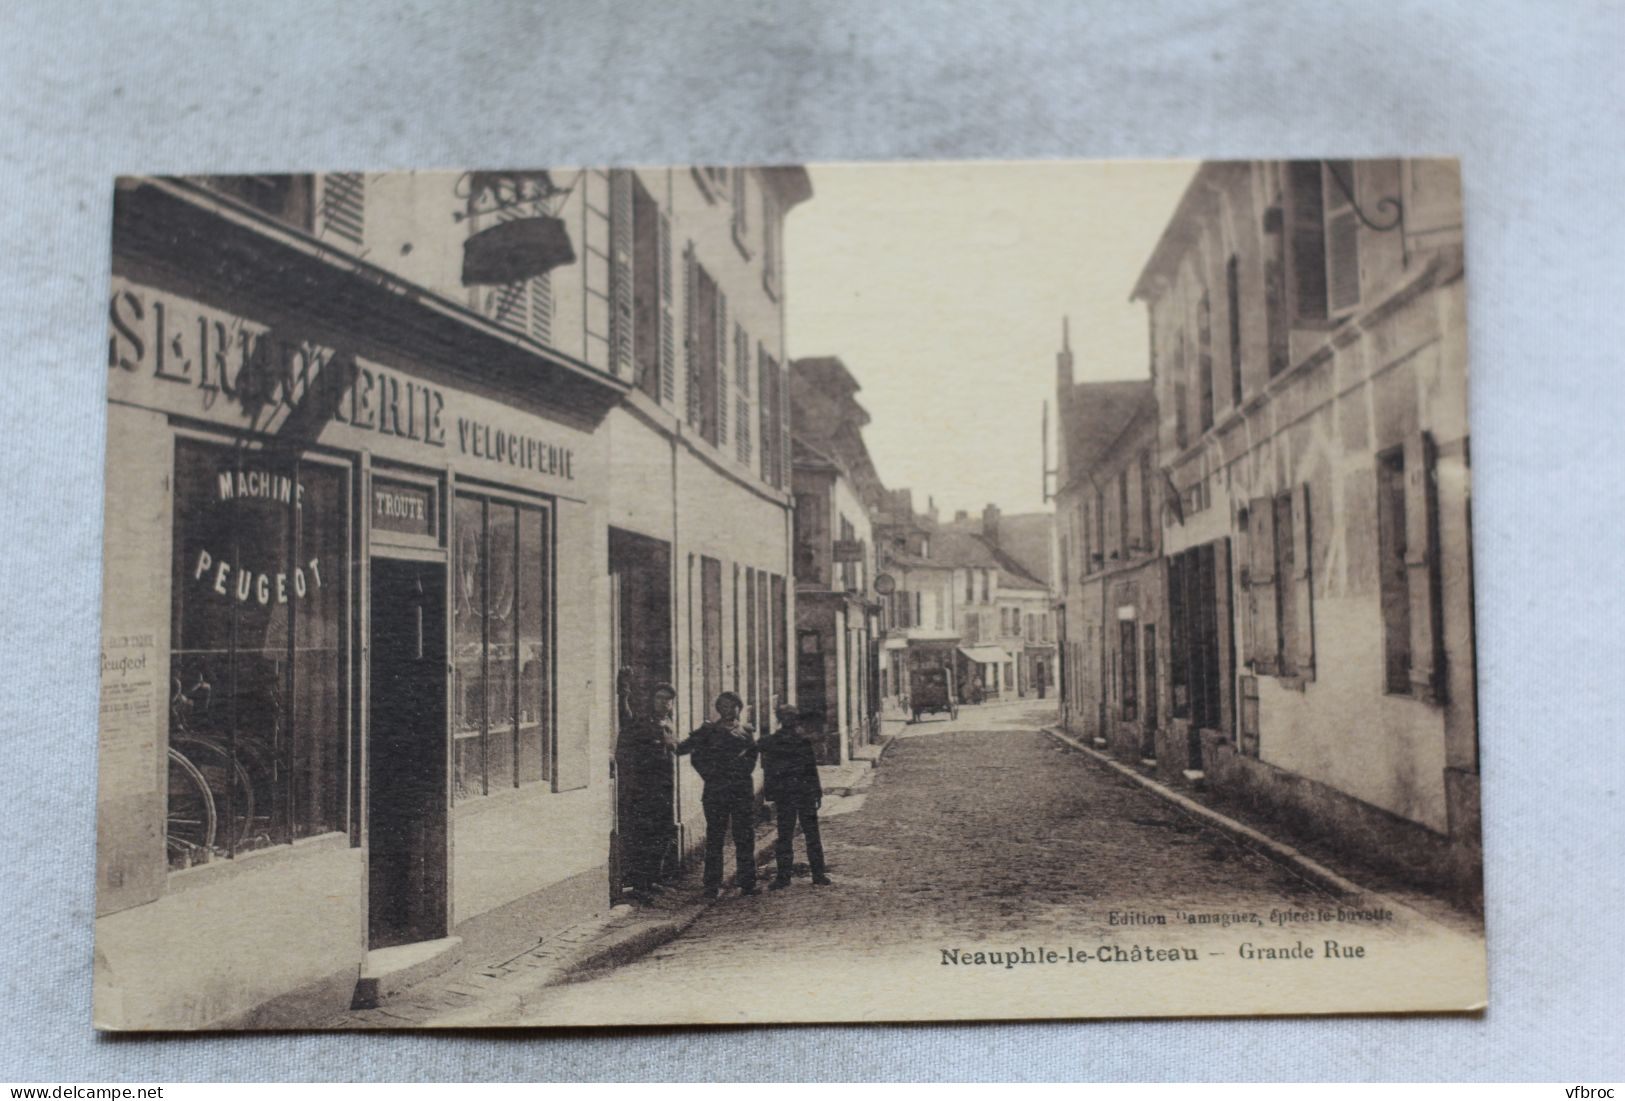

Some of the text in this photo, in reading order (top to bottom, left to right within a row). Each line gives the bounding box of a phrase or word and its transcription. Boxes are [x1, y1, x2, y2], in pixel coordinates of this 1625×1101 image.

[217, 470, 305, 509] MACHINE
[194, 548, 323, 605] PEUGEOT
[940, 945, 1199, 968] Neauphle-le-Château
[1239, 941, 1316, 960] Grande
[1324, 940, 1366, 959] Rue
